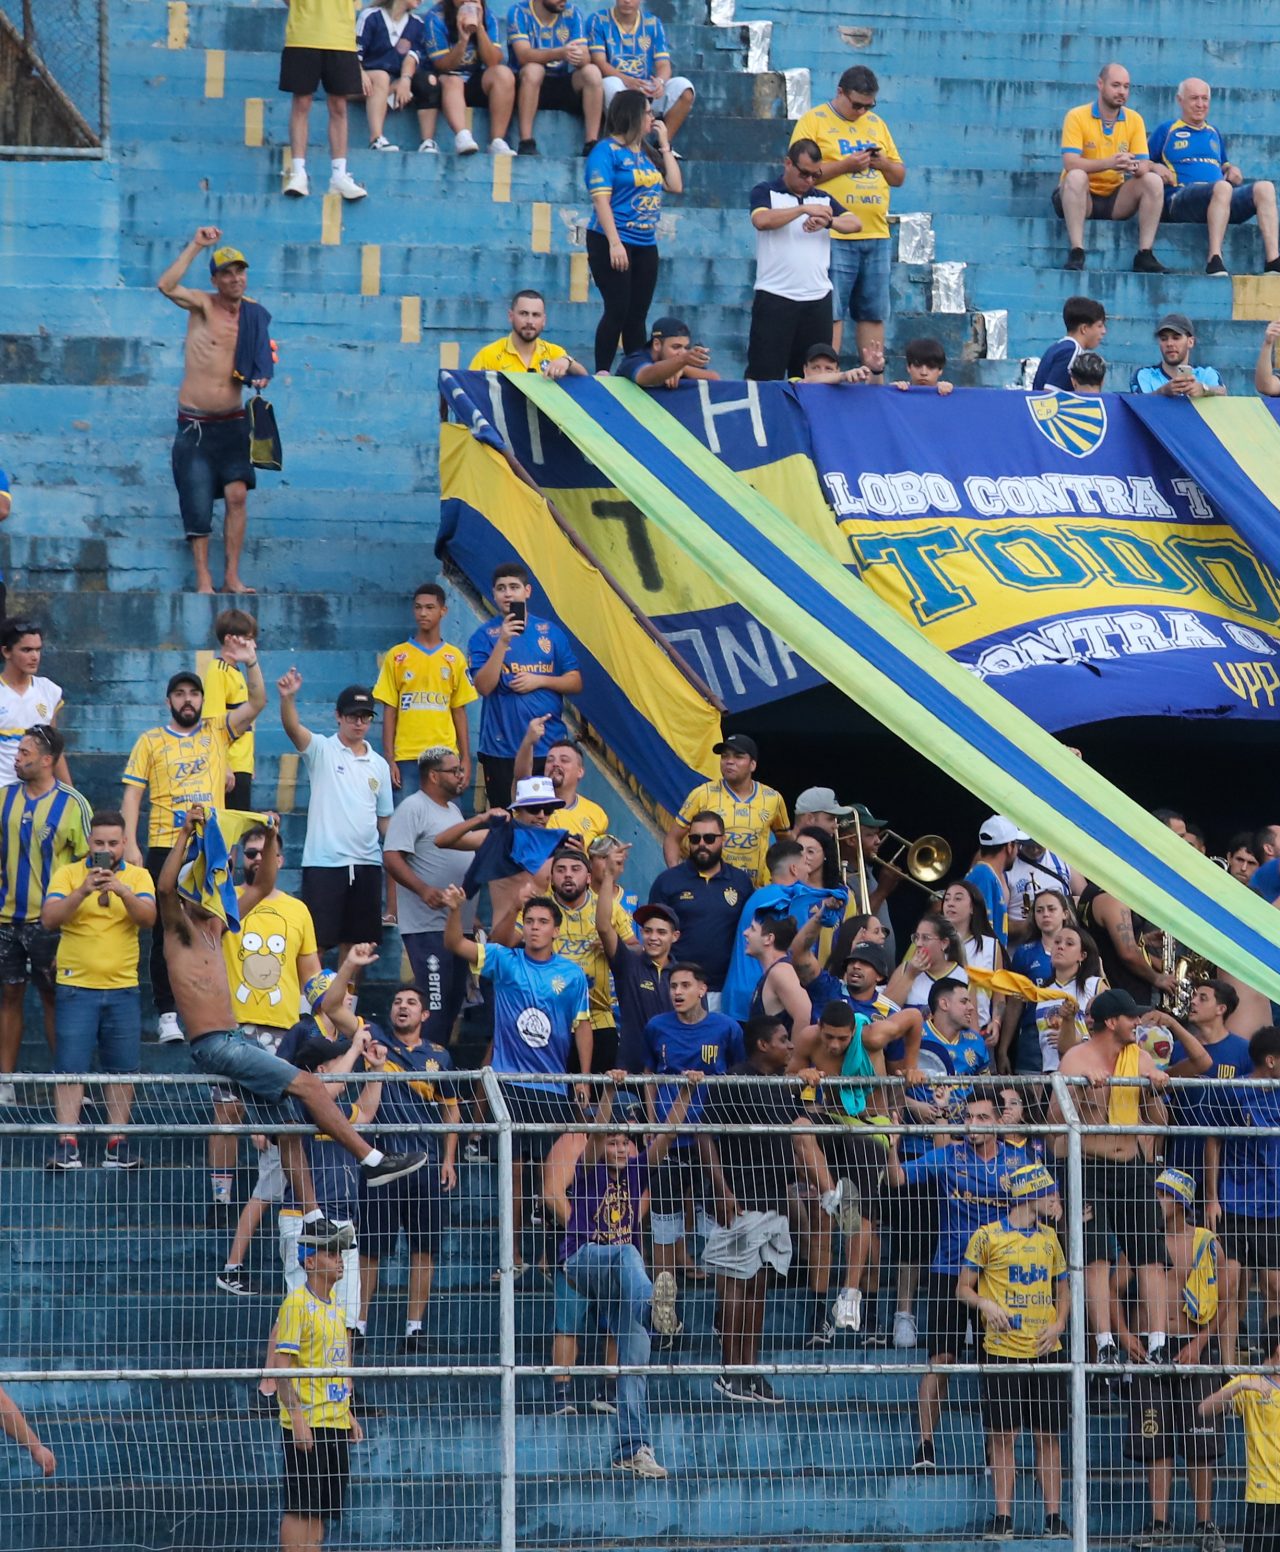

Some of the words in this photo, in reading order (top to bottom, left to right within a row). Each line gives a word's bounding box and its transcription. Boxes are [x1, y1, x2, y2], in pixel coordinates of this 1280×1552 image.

[824, 471, 961, 518] LOBO
[964, 473, 1177, 519] CONTRA
[968, 610, 1227, 683] ONTRA
[1008, 1262, 1049, 1285] Bob's
